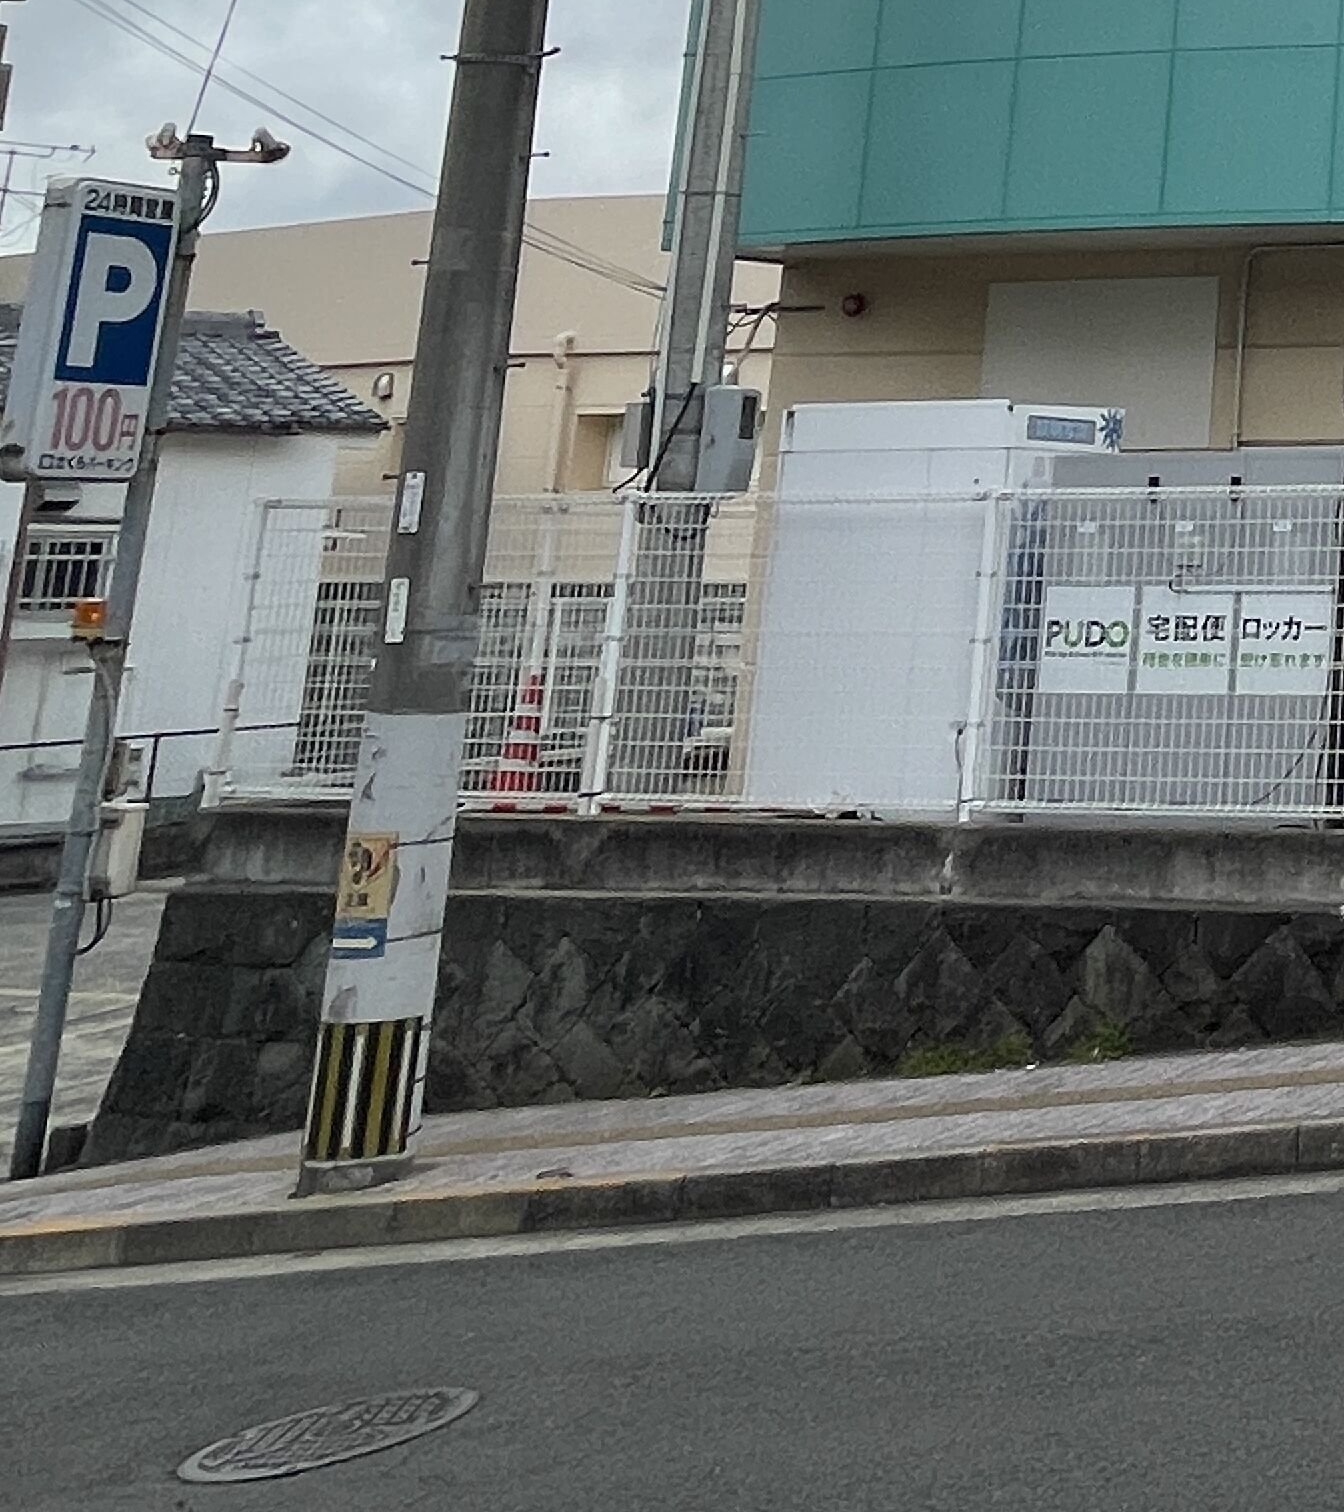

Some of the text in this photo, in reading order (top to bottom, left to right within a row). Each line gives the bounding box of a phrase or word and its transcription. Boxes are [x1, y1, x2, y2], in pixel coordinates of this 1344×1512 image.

[65, 230, 158, 368] P
[51, 387, 139, 452] 100円
[1046, 620, 1130, 648] PUDO
[1148, 614, 1328, 642] 宅配便 ロッカー
